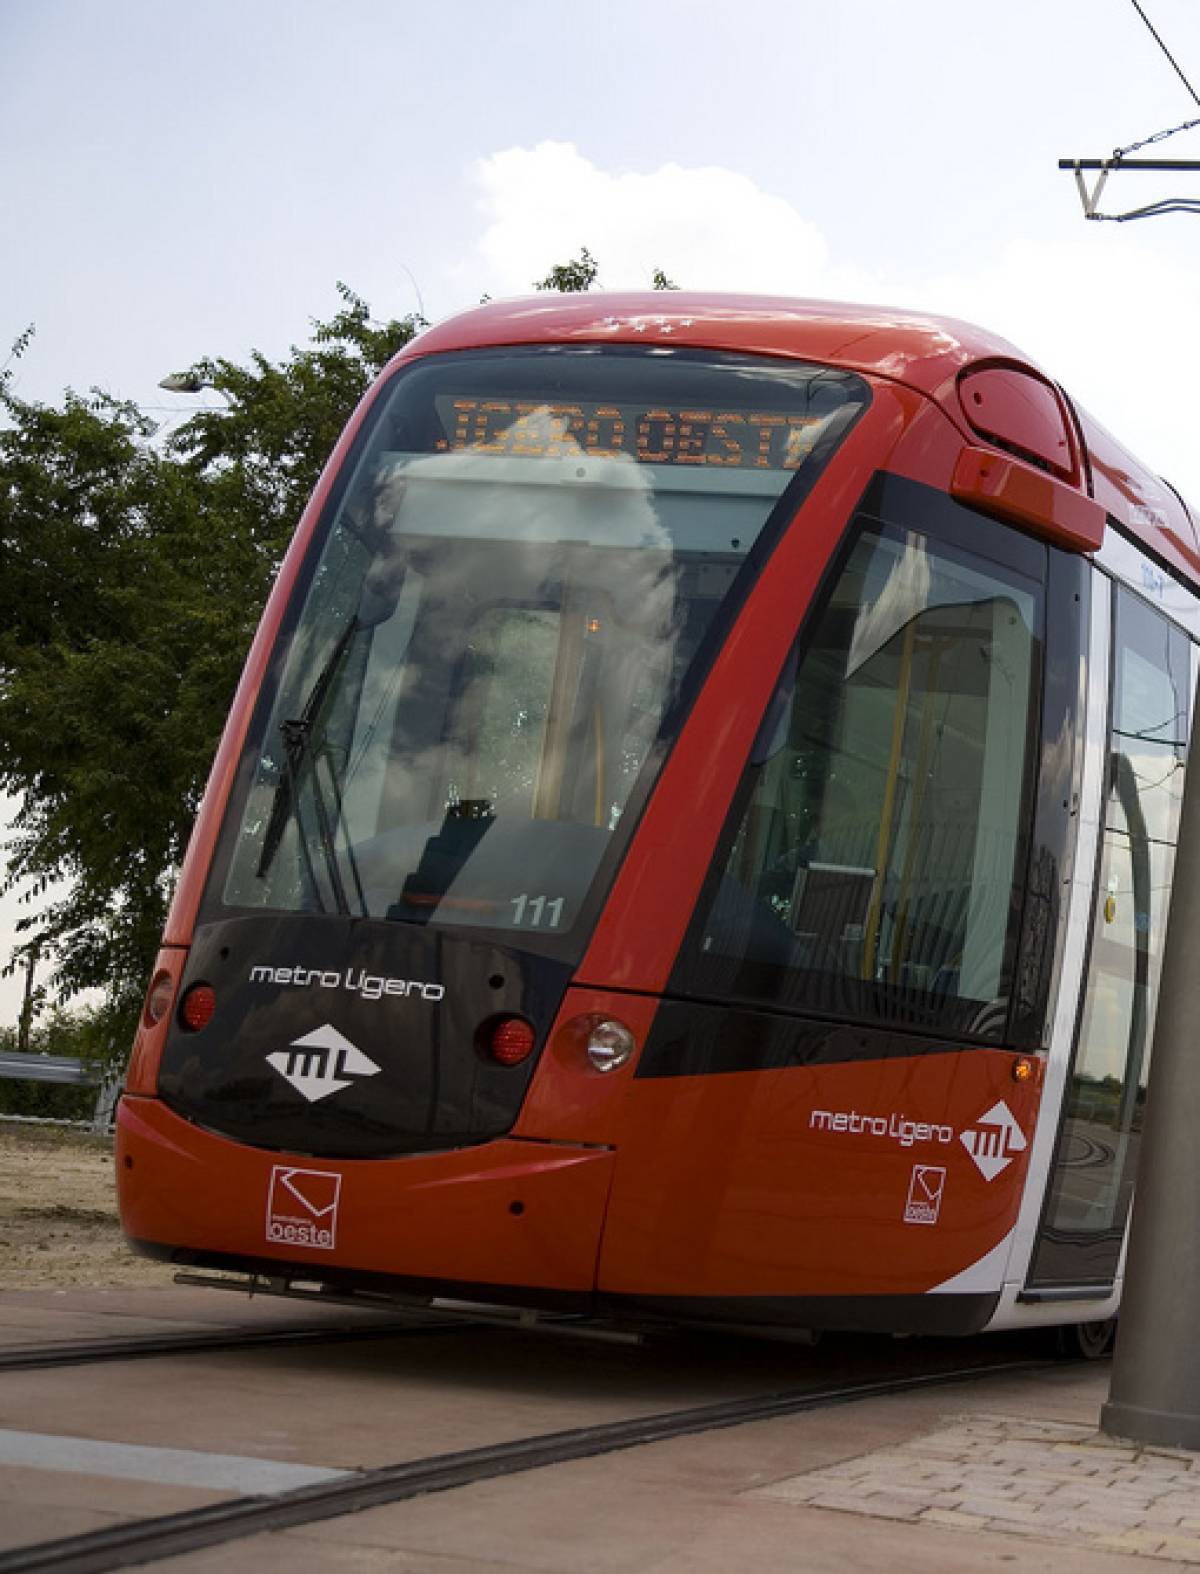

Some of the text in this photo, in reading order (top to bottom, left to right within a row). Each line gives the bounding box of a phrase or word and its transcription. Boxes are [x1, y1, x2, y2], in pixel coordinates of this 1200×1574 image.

[511, 894, 564, 927] 111
[249, 965, 446, 1001] metro ligero
[808, 1110, 953, 1147] metro ligero
